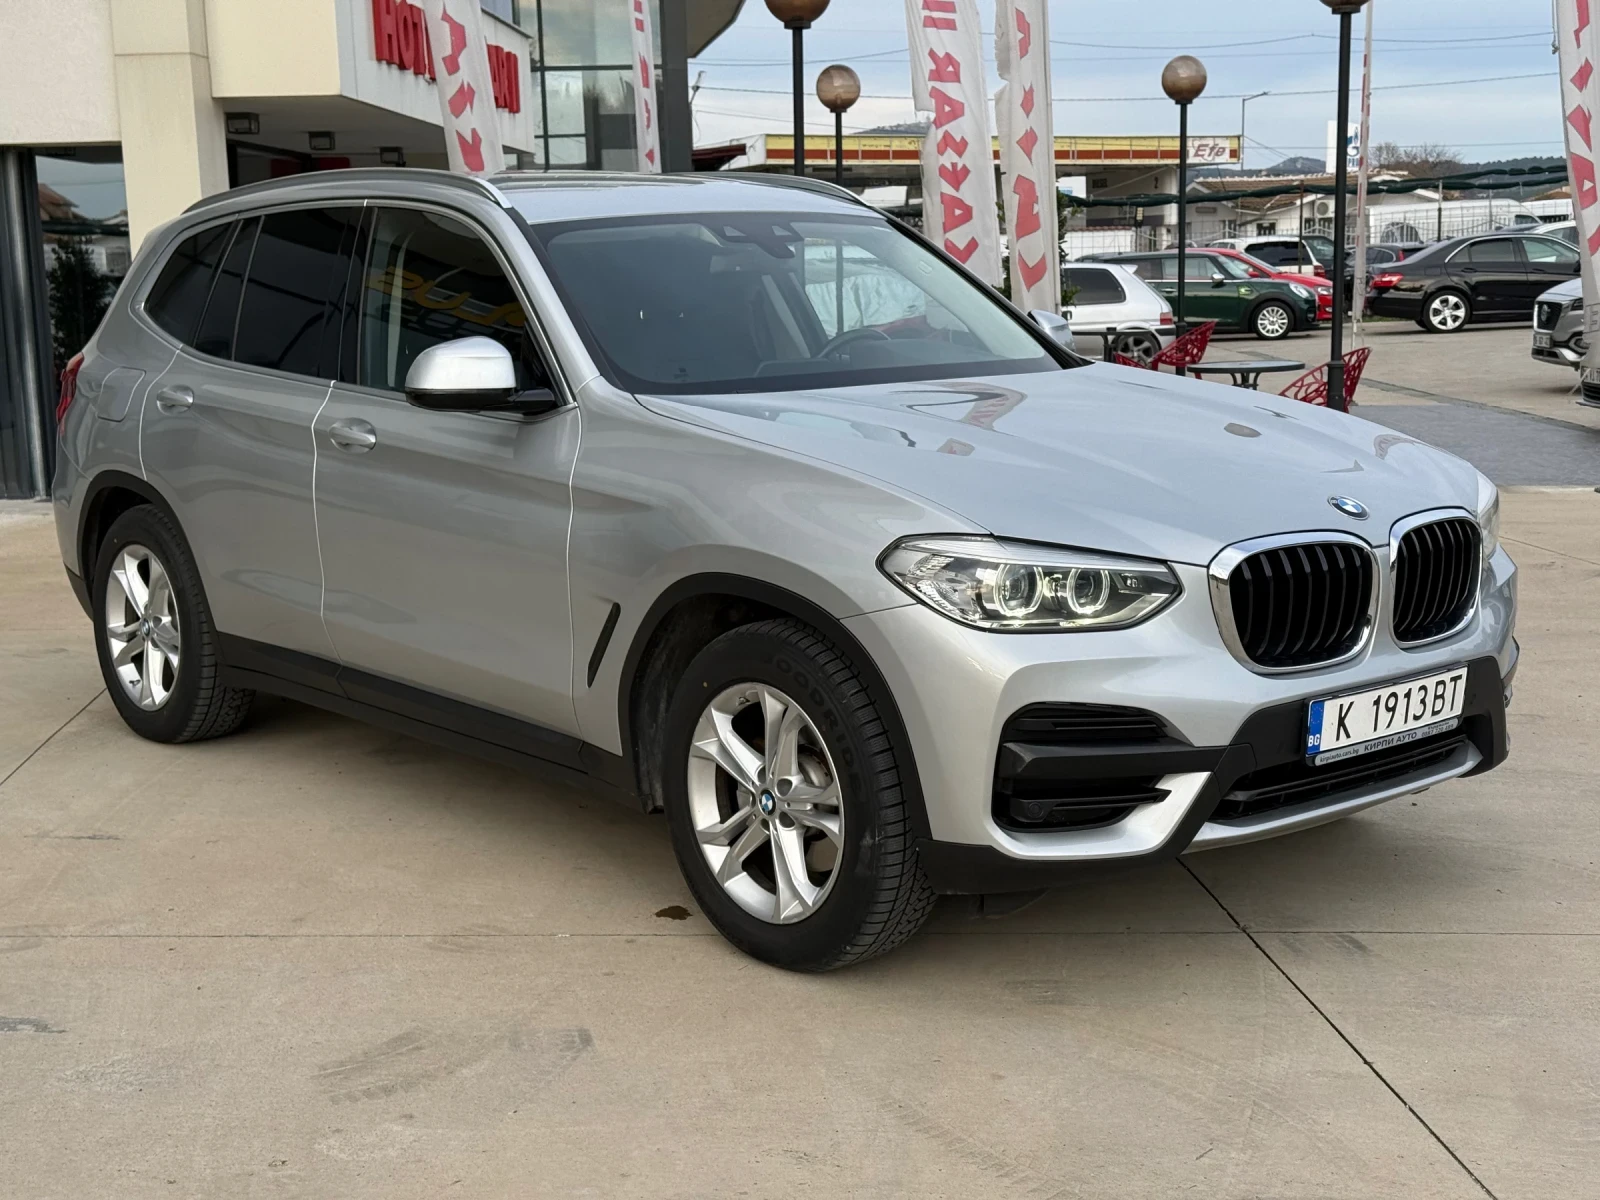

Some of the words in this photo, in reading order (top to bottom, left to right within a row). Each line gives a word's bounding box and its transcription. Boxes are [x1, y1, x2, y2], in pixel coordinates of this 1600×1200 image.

[372, 0, 436, 82] HOT
[1335, 701, 1355, 742] K
[1372, 674, 1463, 733] 1913BT
[1308, 735, 1320, 747] BG
[1364, 737, 1395, 752] КИРПИ
[1396, 731, 1418, 745] АУТО
[1319, 748, 1360, 763] kirpiauto.cars.bg
